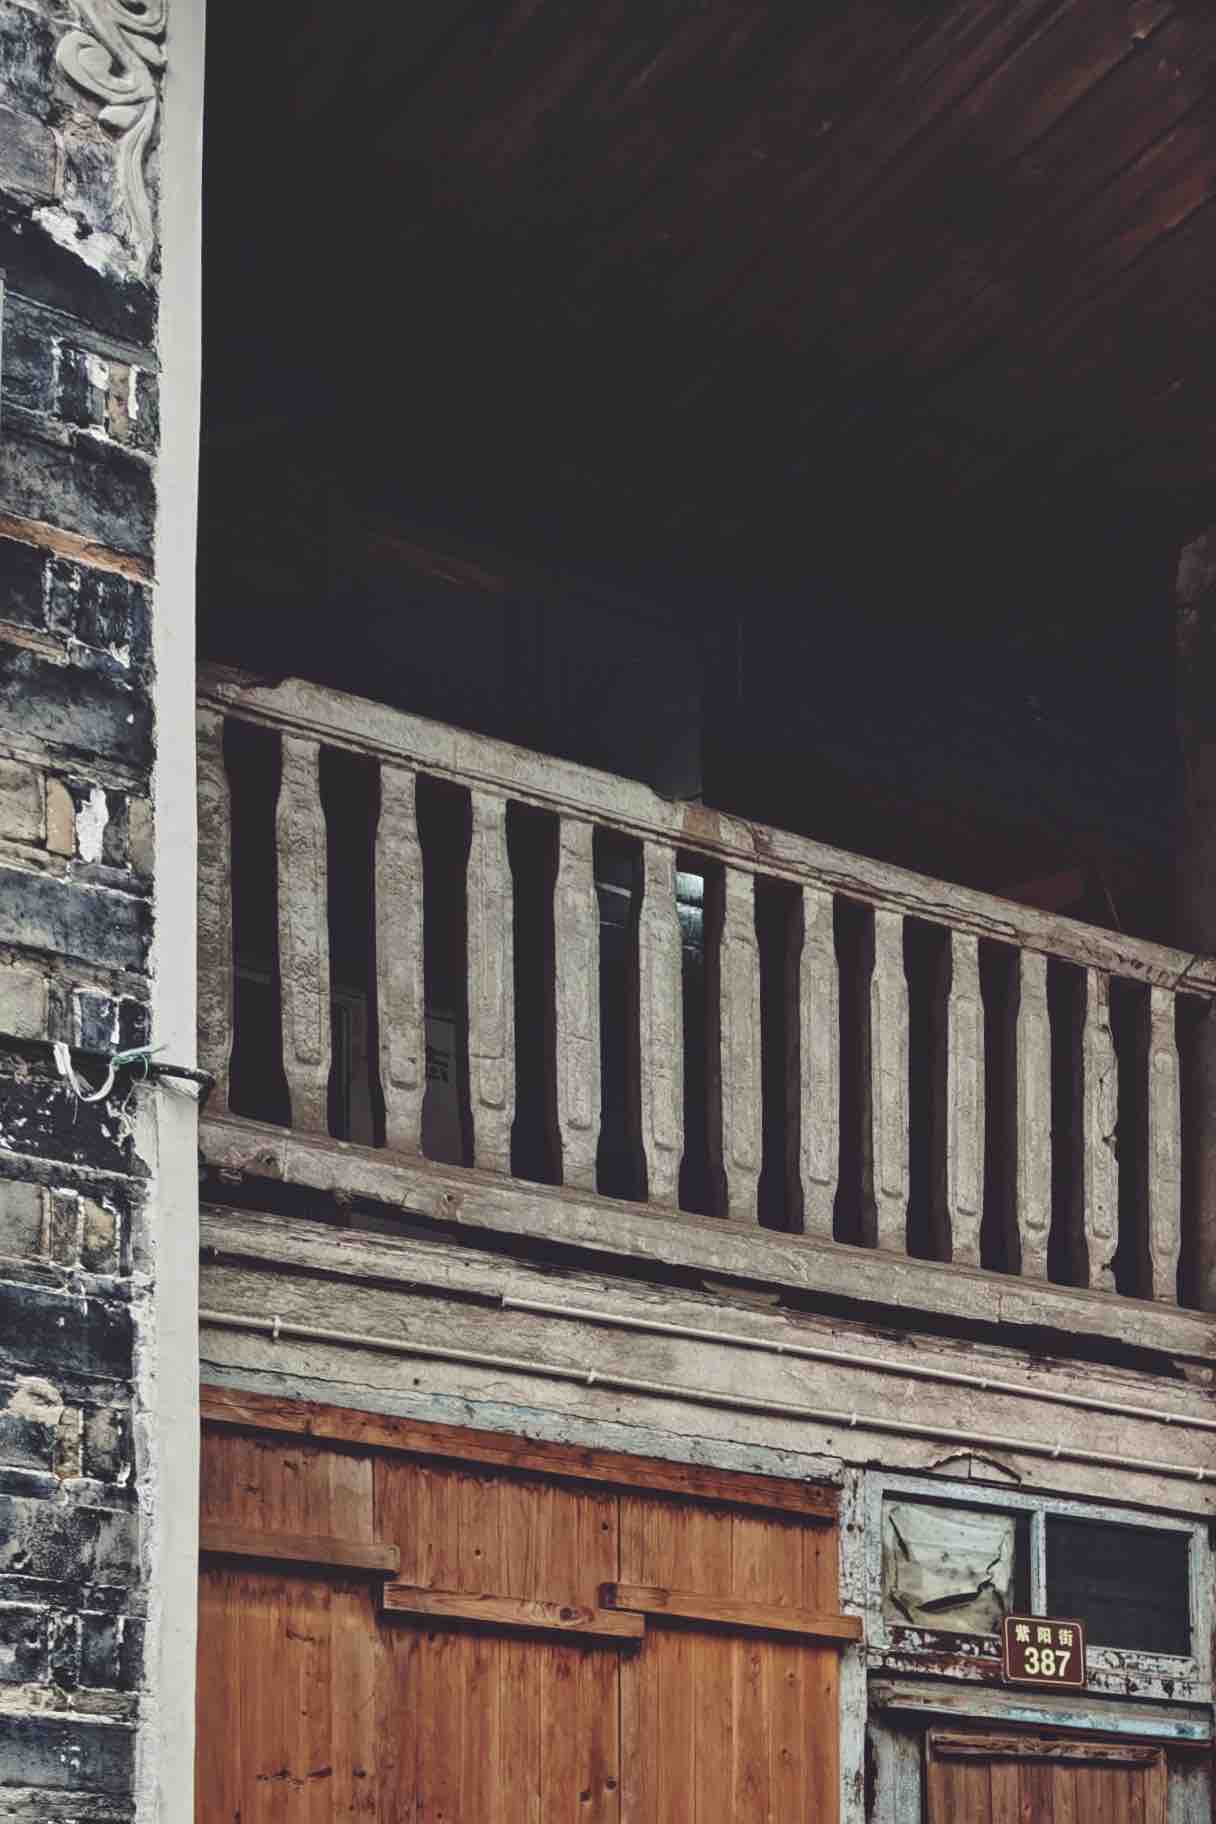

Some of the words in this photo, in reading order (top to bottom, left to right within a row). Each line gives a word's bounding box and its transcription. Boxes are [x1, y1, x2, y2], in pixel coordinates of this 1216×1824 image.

[1015, 1624, 1073, 1647] 紫阳街
[1024, 1646, 1071, 1678] 387
